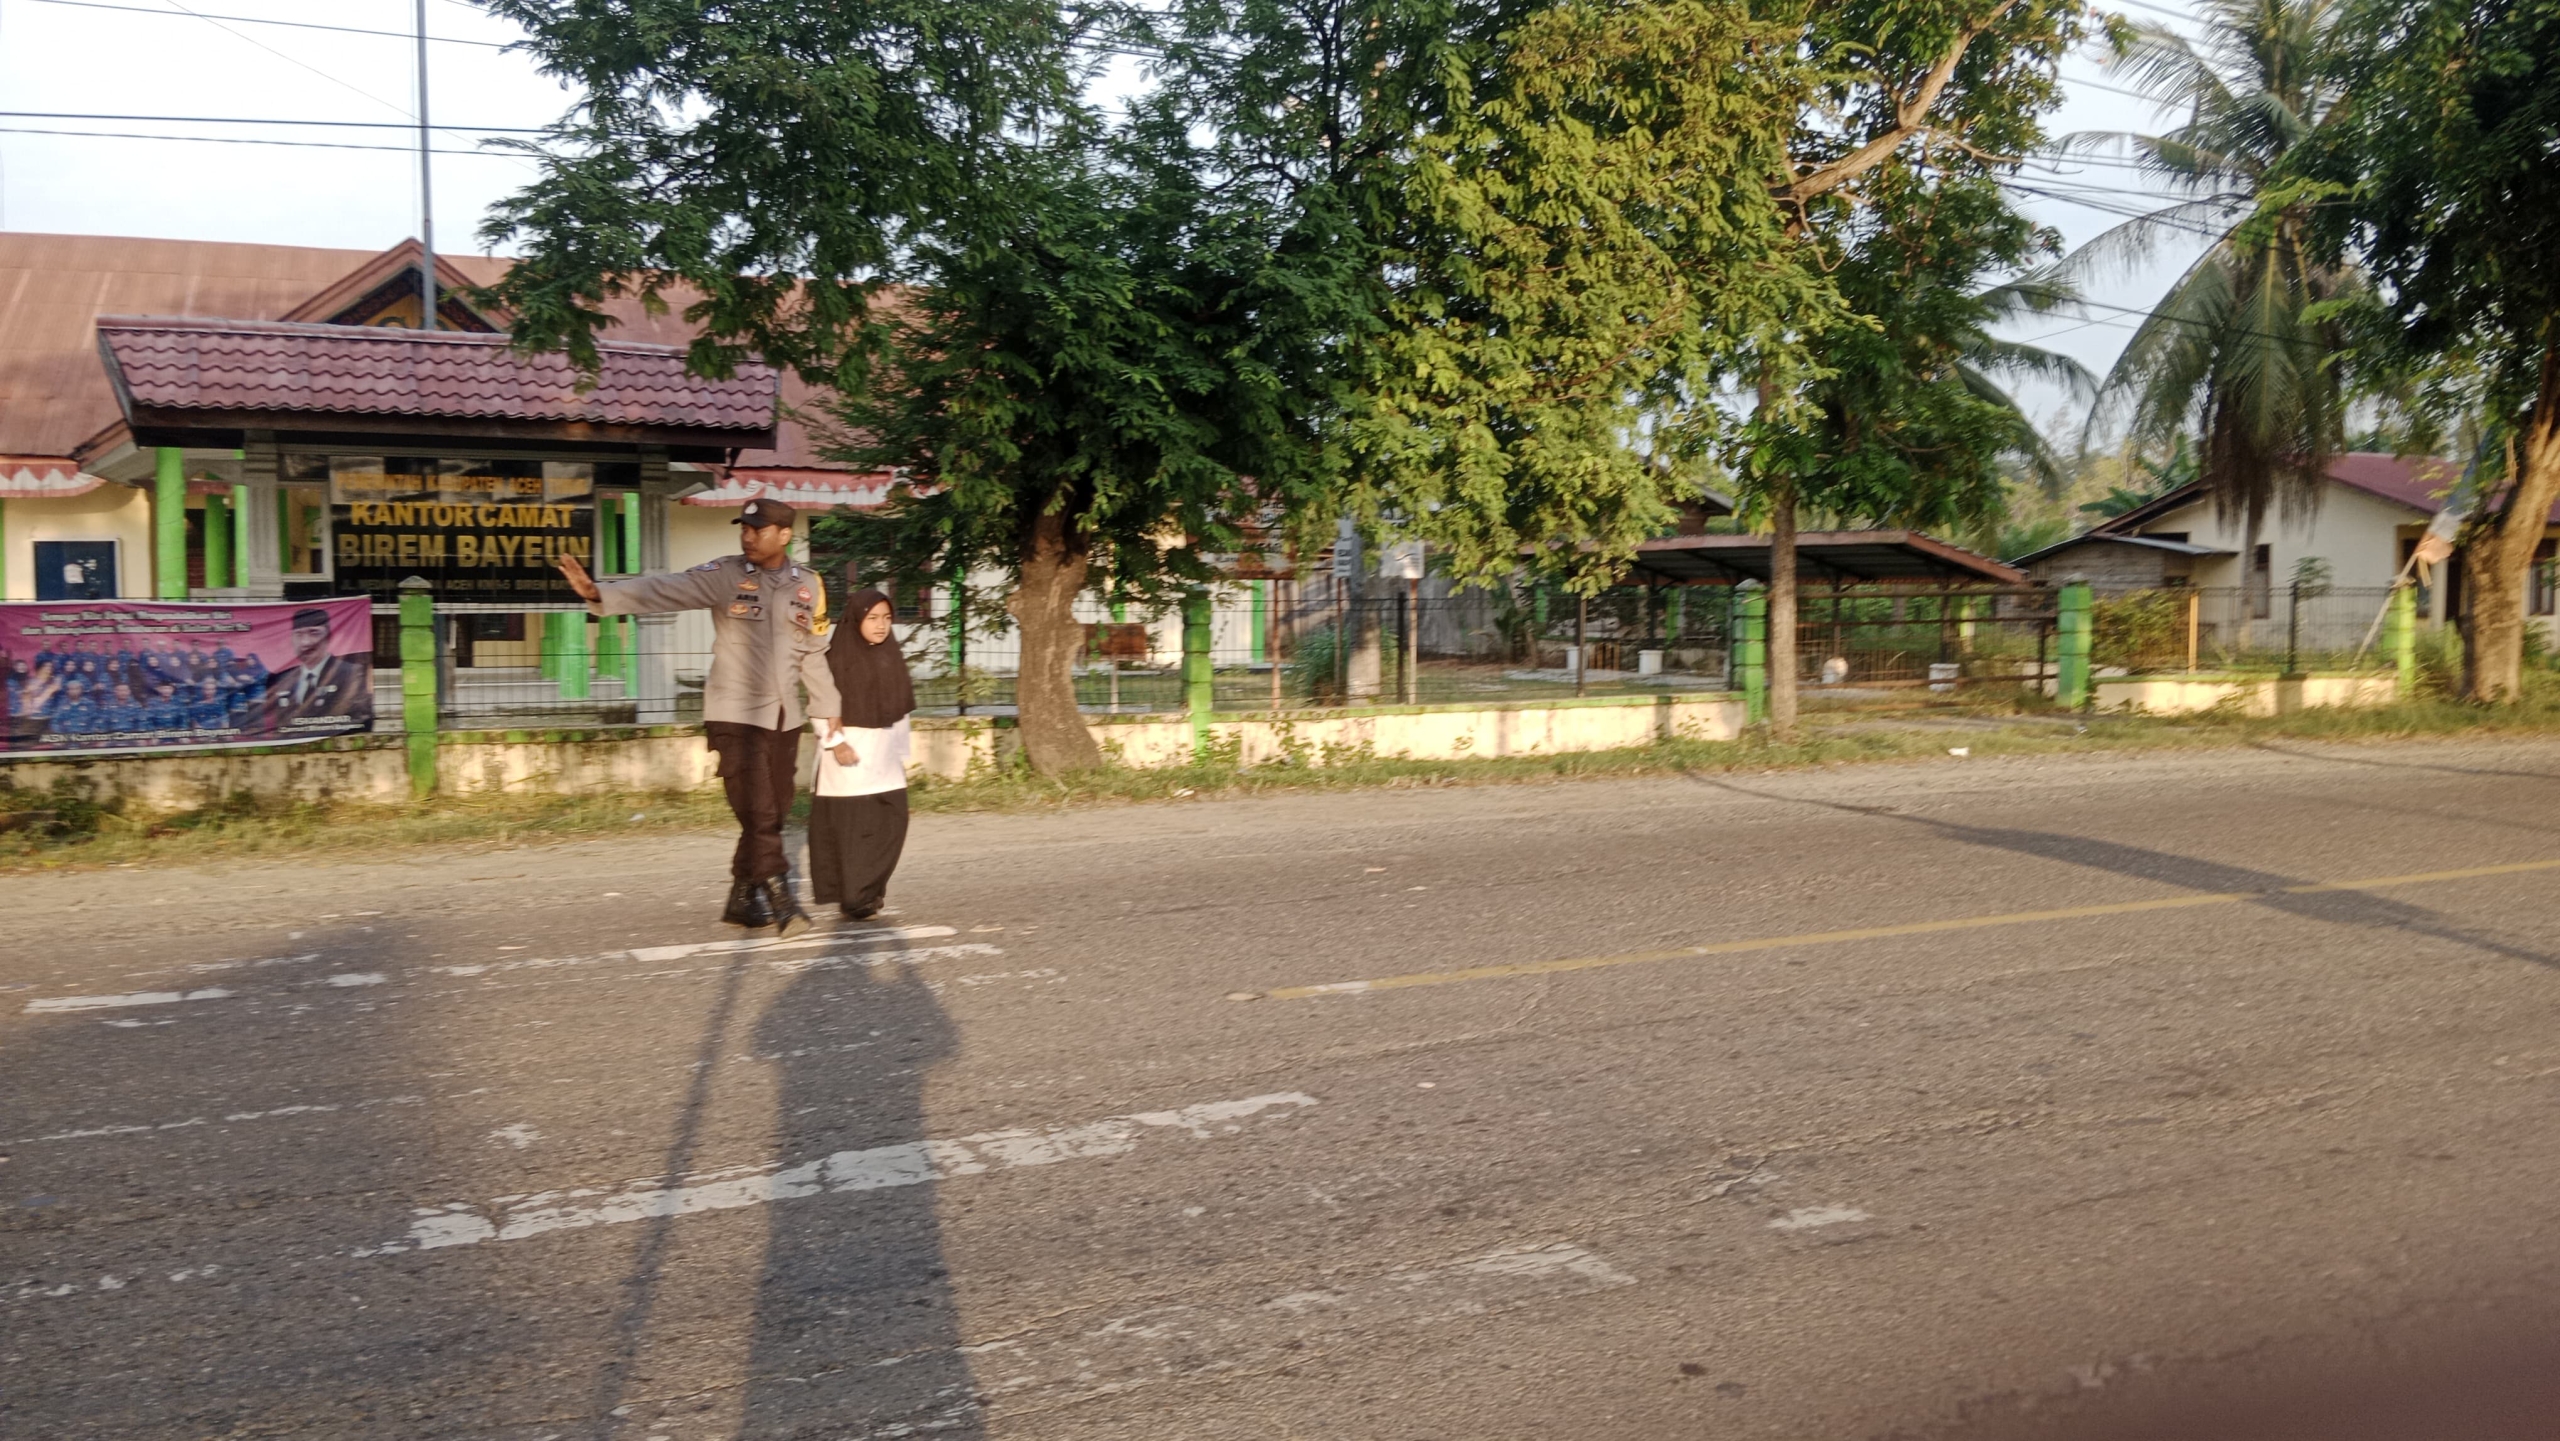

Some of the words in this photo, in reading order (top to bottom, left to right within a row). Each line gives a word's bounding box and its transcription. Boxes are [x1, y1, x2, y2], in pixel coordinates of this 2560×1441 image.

[426, 475, 504, 492] KABUPATEN
[509, 477, 543, 494] ACEH
[350, 501, 475, 527] KANTOR
[477, 504, 575, 529] CAMAT
[338, 534, 446, 567] BIREM
[456, 535, 590, 568] BAYEUN
